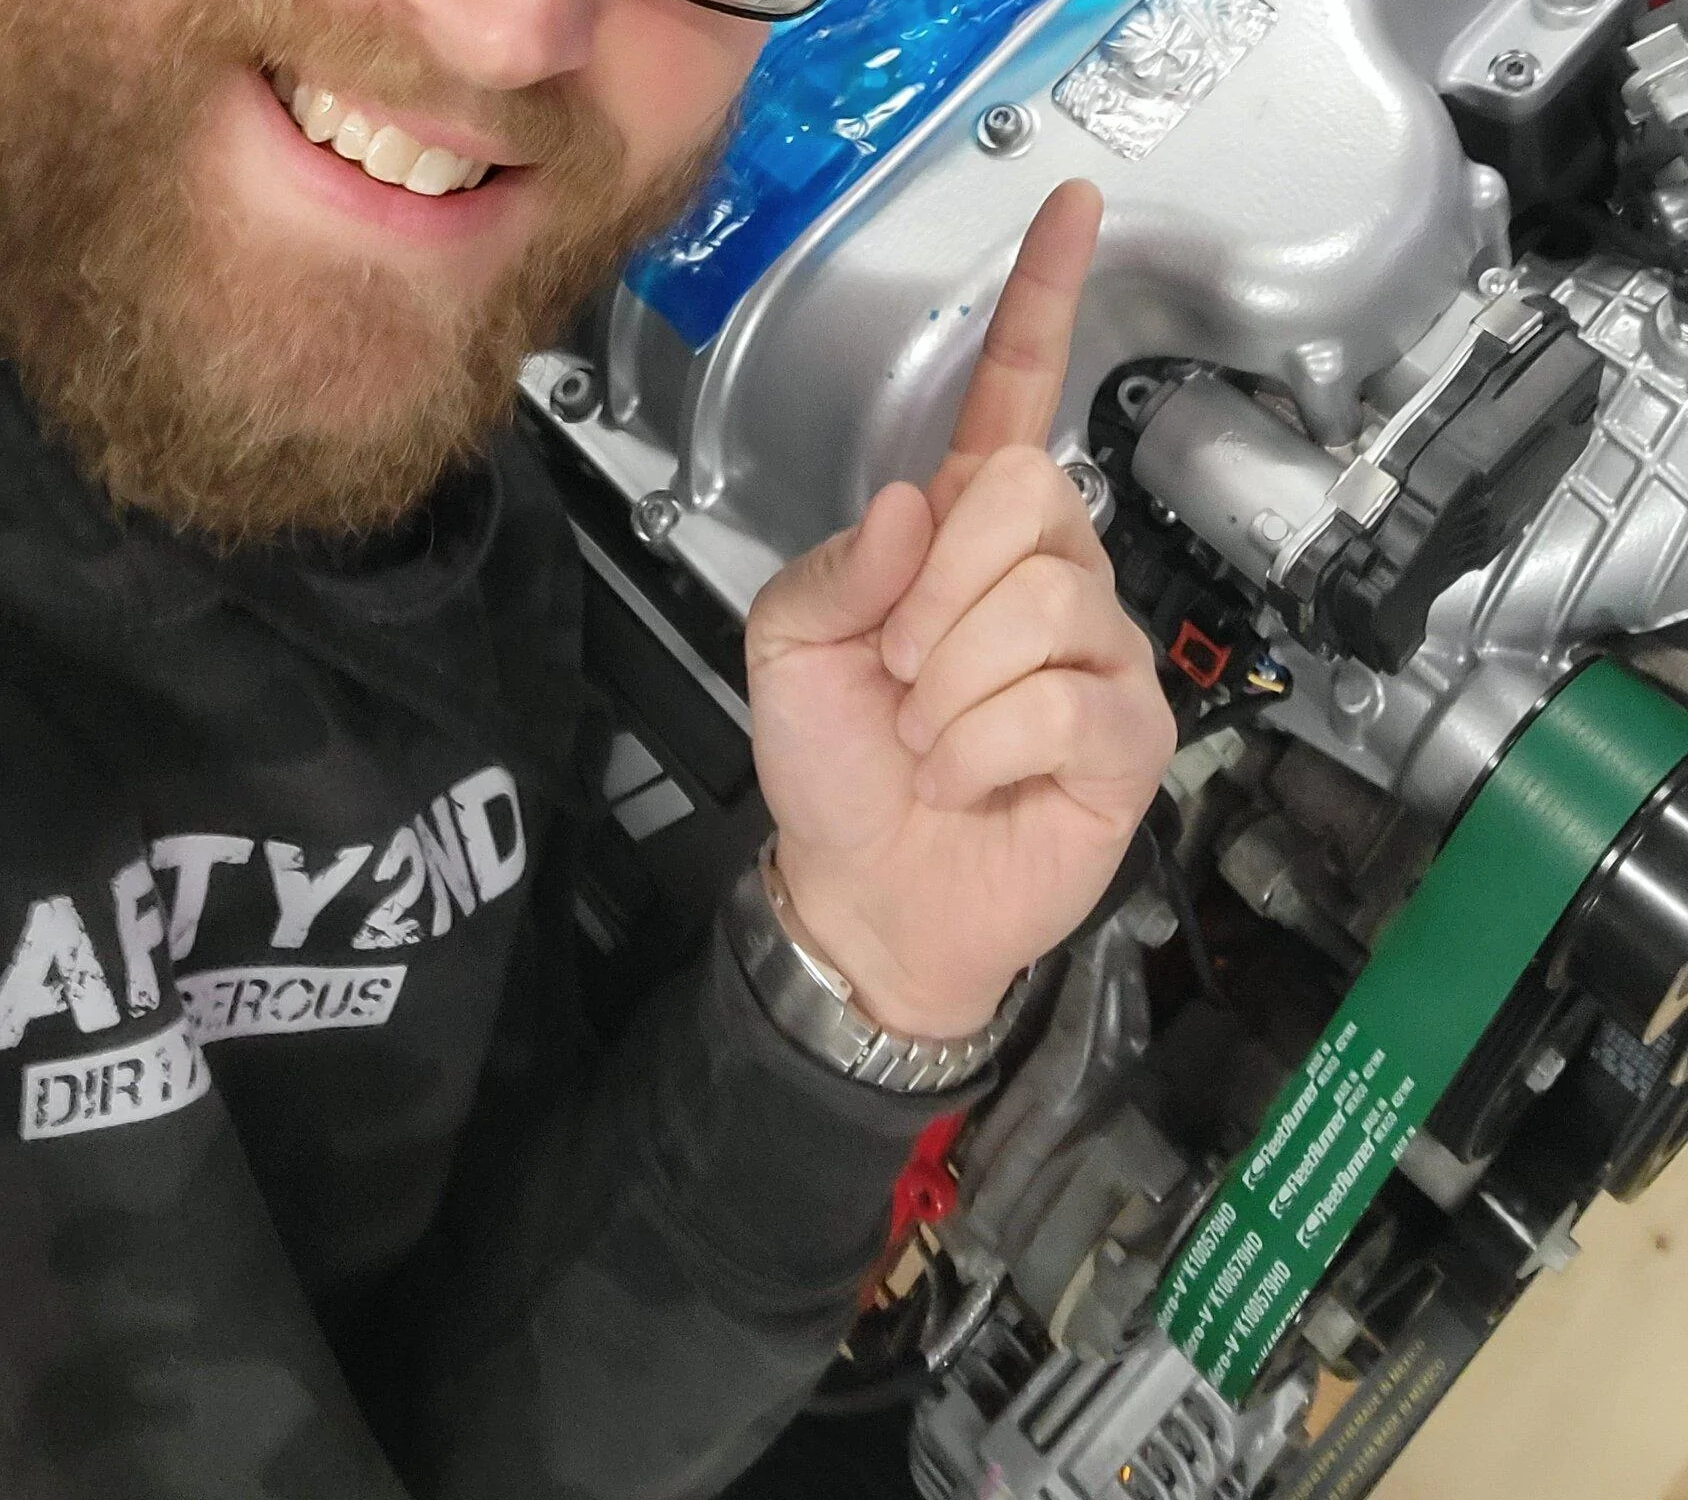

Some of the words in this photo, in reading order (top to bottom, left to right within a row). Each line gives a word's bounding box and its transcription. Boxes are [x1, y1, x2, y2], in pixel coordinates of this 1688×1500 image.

[1182, 1202, 1236, 1280] K100579HD
[1209, 1231, 1263, 1309] K100579HD
[1235, 1260, 1291, 1337] K100579HD
